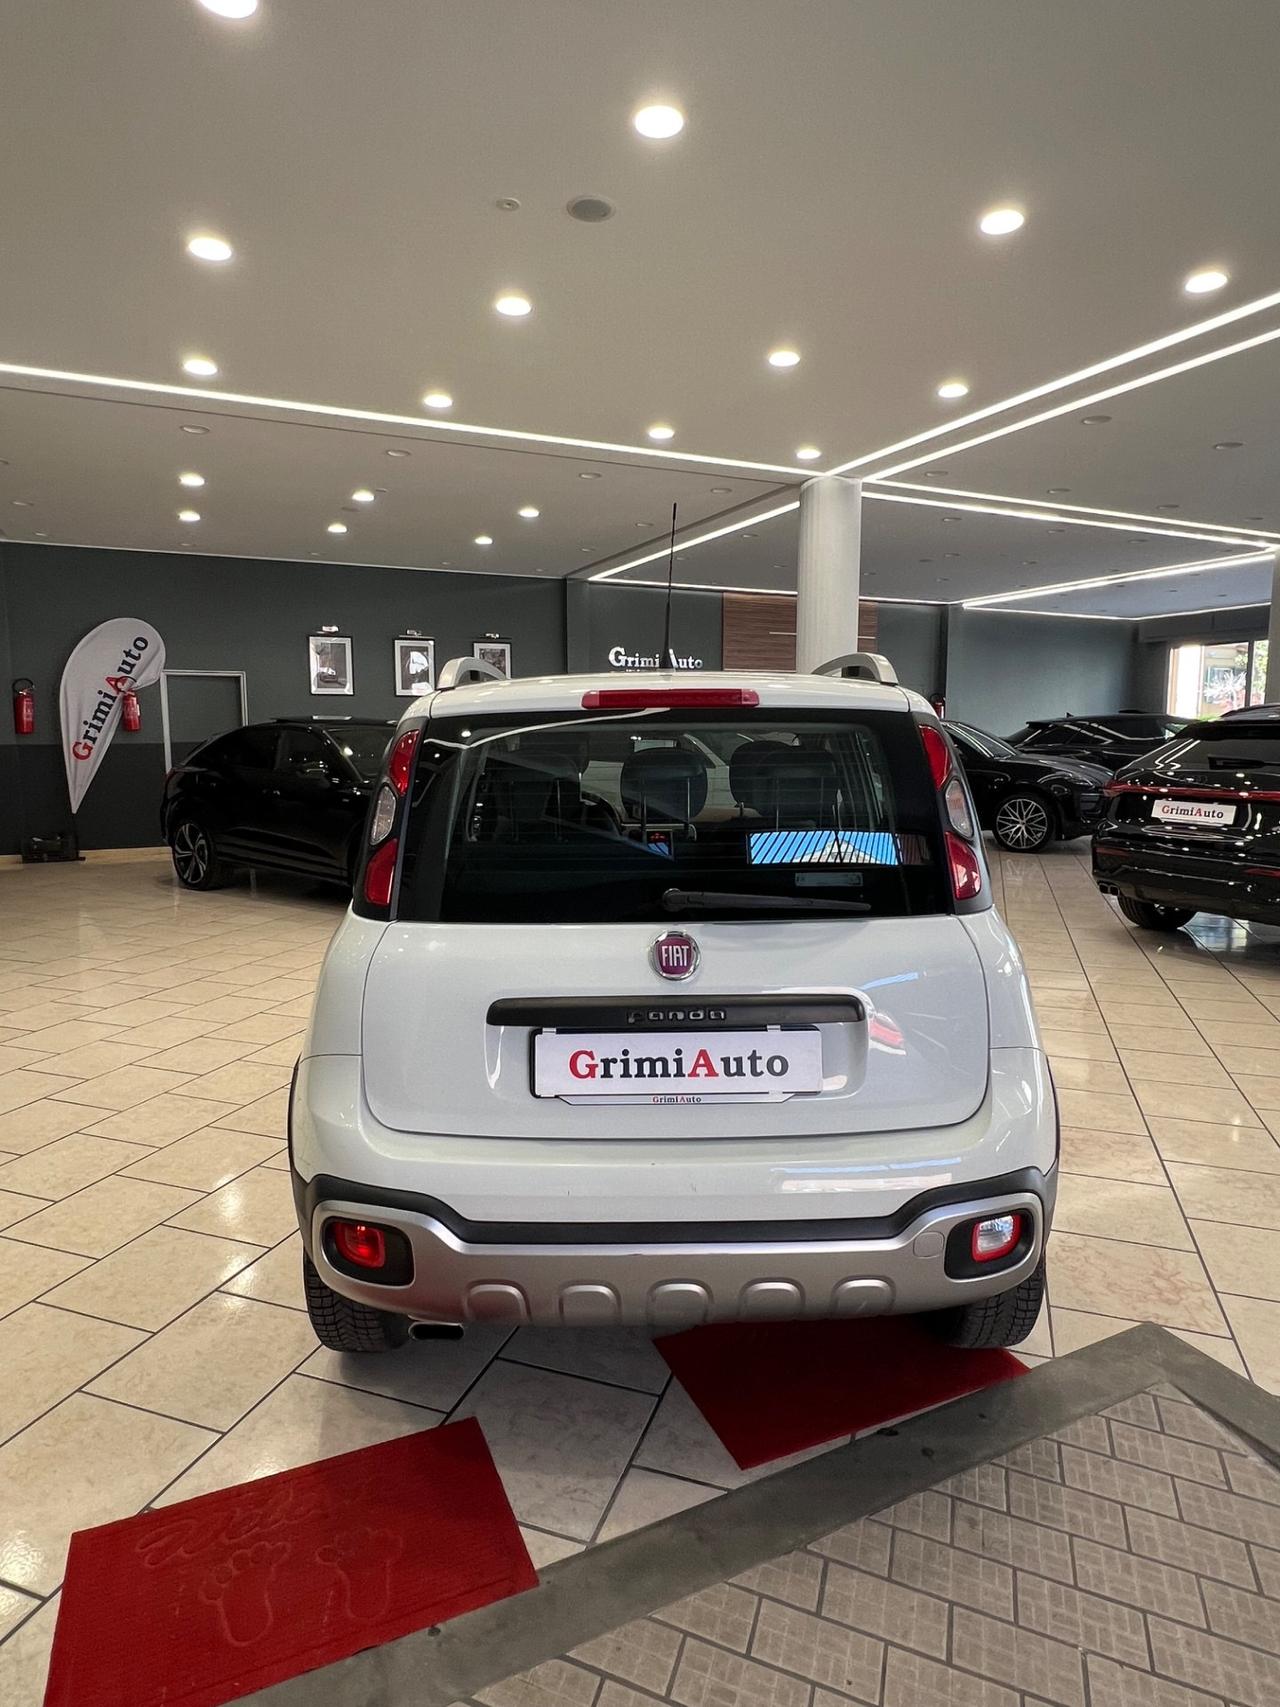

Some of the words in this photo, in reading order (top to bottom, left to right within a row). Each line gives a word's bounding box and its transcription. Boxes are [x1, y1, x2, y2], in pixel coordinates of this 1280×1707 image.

[72, 636, 149, 760] GrimiAuto
[1161, 804, 1224, 819] GrimiAuto
[661, 945, 690, 967] FIAT
[569, 1048, 789, 1080] GrimiAuto
[652, 1095, 702, 1104] GrimiAuto
